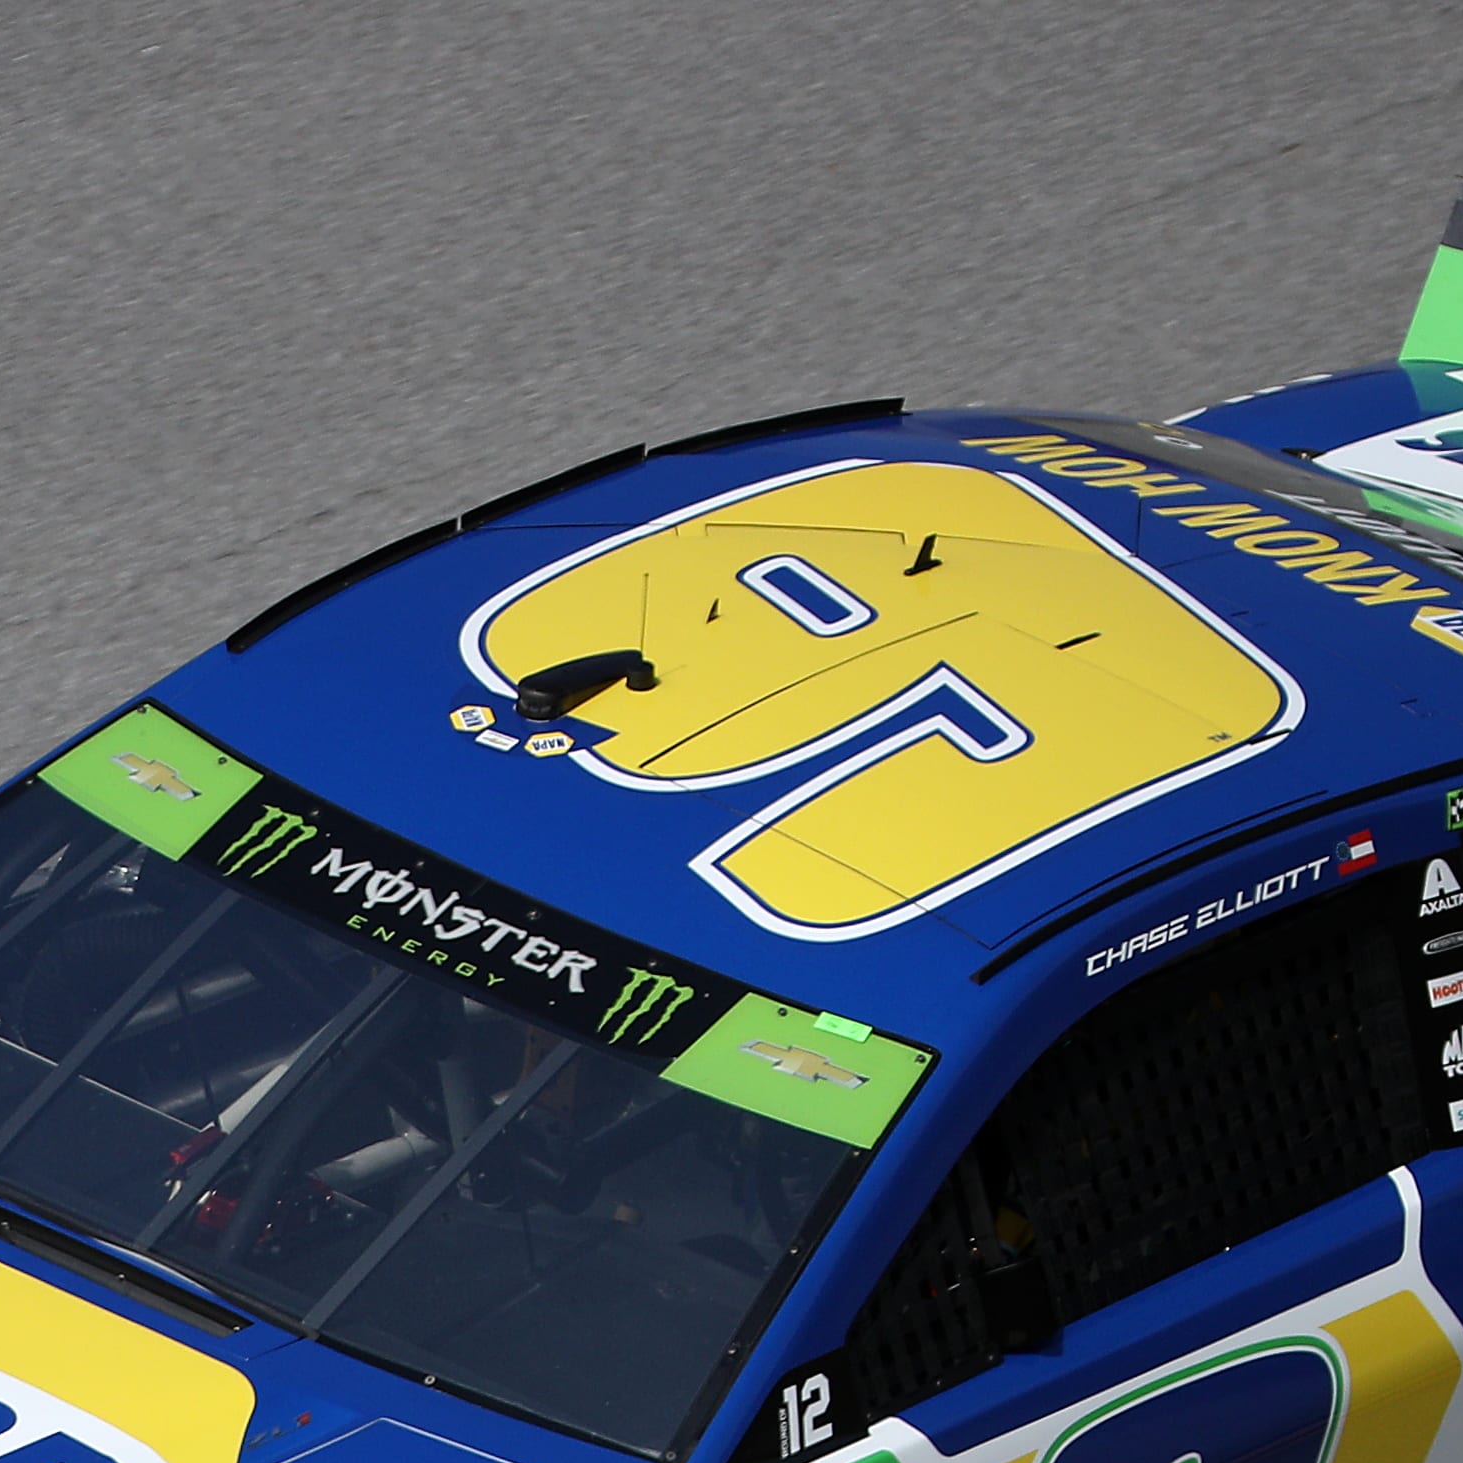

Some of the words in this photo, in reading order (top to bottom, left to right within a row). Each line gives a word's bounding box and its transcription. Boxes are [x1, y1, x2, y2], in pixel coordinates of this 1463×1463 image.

[960, 434, 1206, 498] HOW
[1151, 503, 1449, 606] KNOW
[458, 458, 1308, 942] 9
[532, 737, 566, 751] NAPA
[311, 847, 597, 994] MONSTER
[346, 914, 506, 988] ENERGY
[1086, 914, 1189, 977] CHASE
[1195, 856, 1330, 929] ELLIOTT
[783, 1372, 834, 1456] 12
